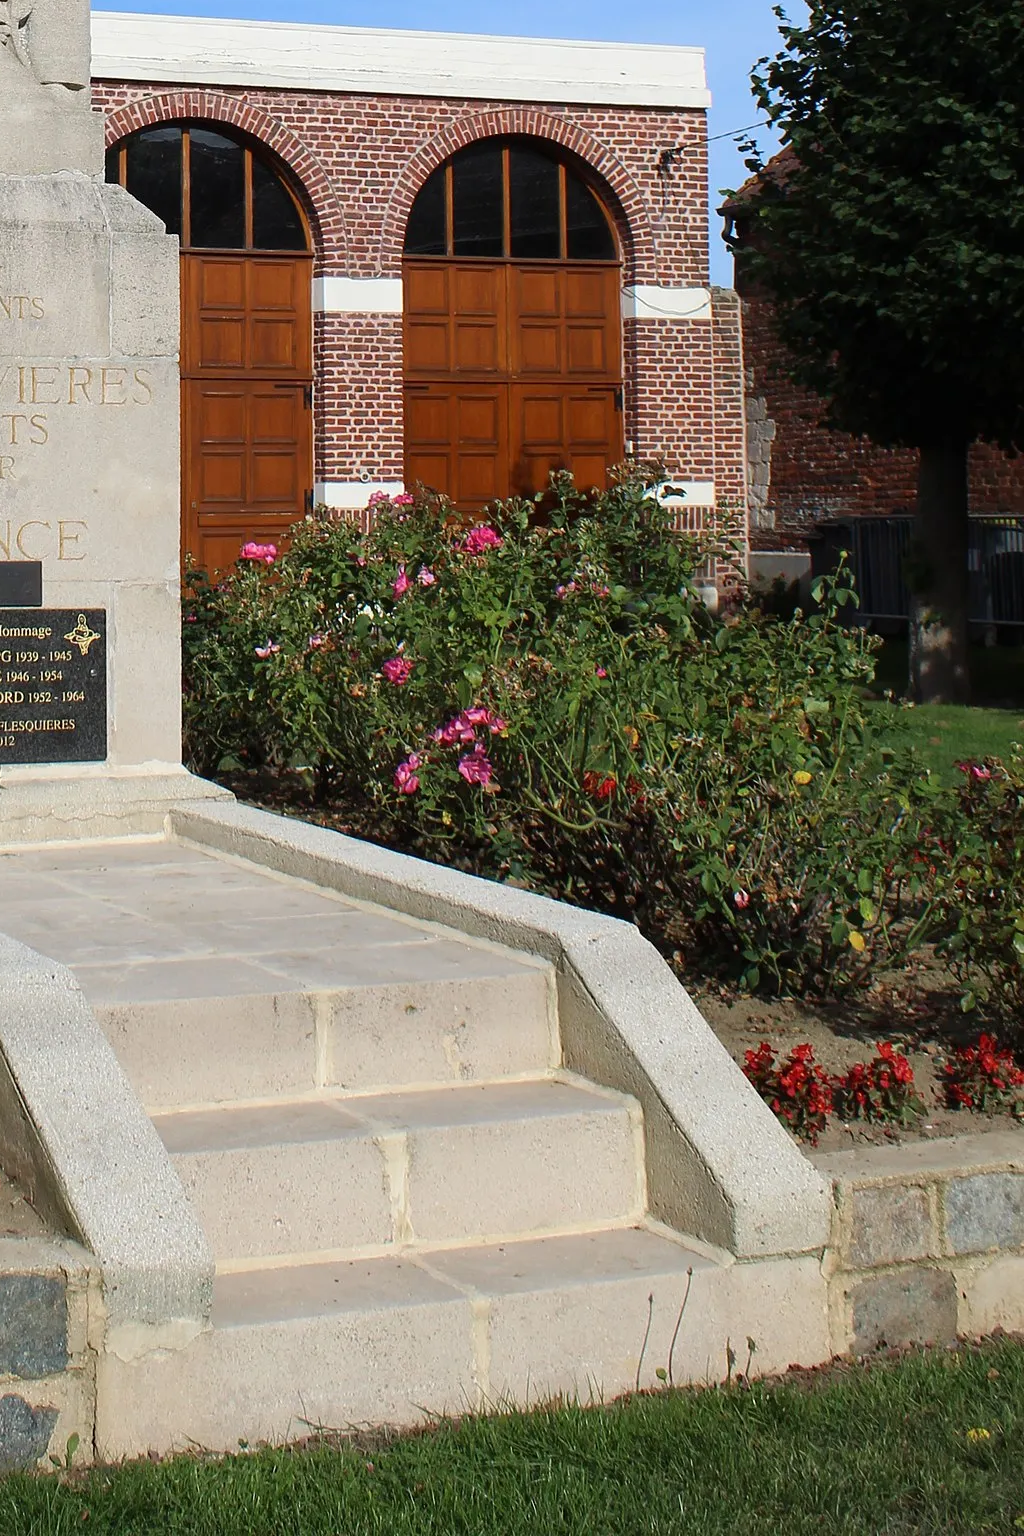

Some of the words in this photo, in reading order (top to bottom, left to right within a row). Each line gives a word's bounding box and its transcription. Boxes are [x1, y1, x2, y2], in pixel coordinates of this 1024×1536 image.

[15, 651, 39, 662] 1939
[49, 650, 72, 662] 1945
[6, 670, 30, 682] 1946
[40, 670, 63, 681] 1954
[28, 691, 52, 703] 1952
[62, 691, 85, 702] 1964
